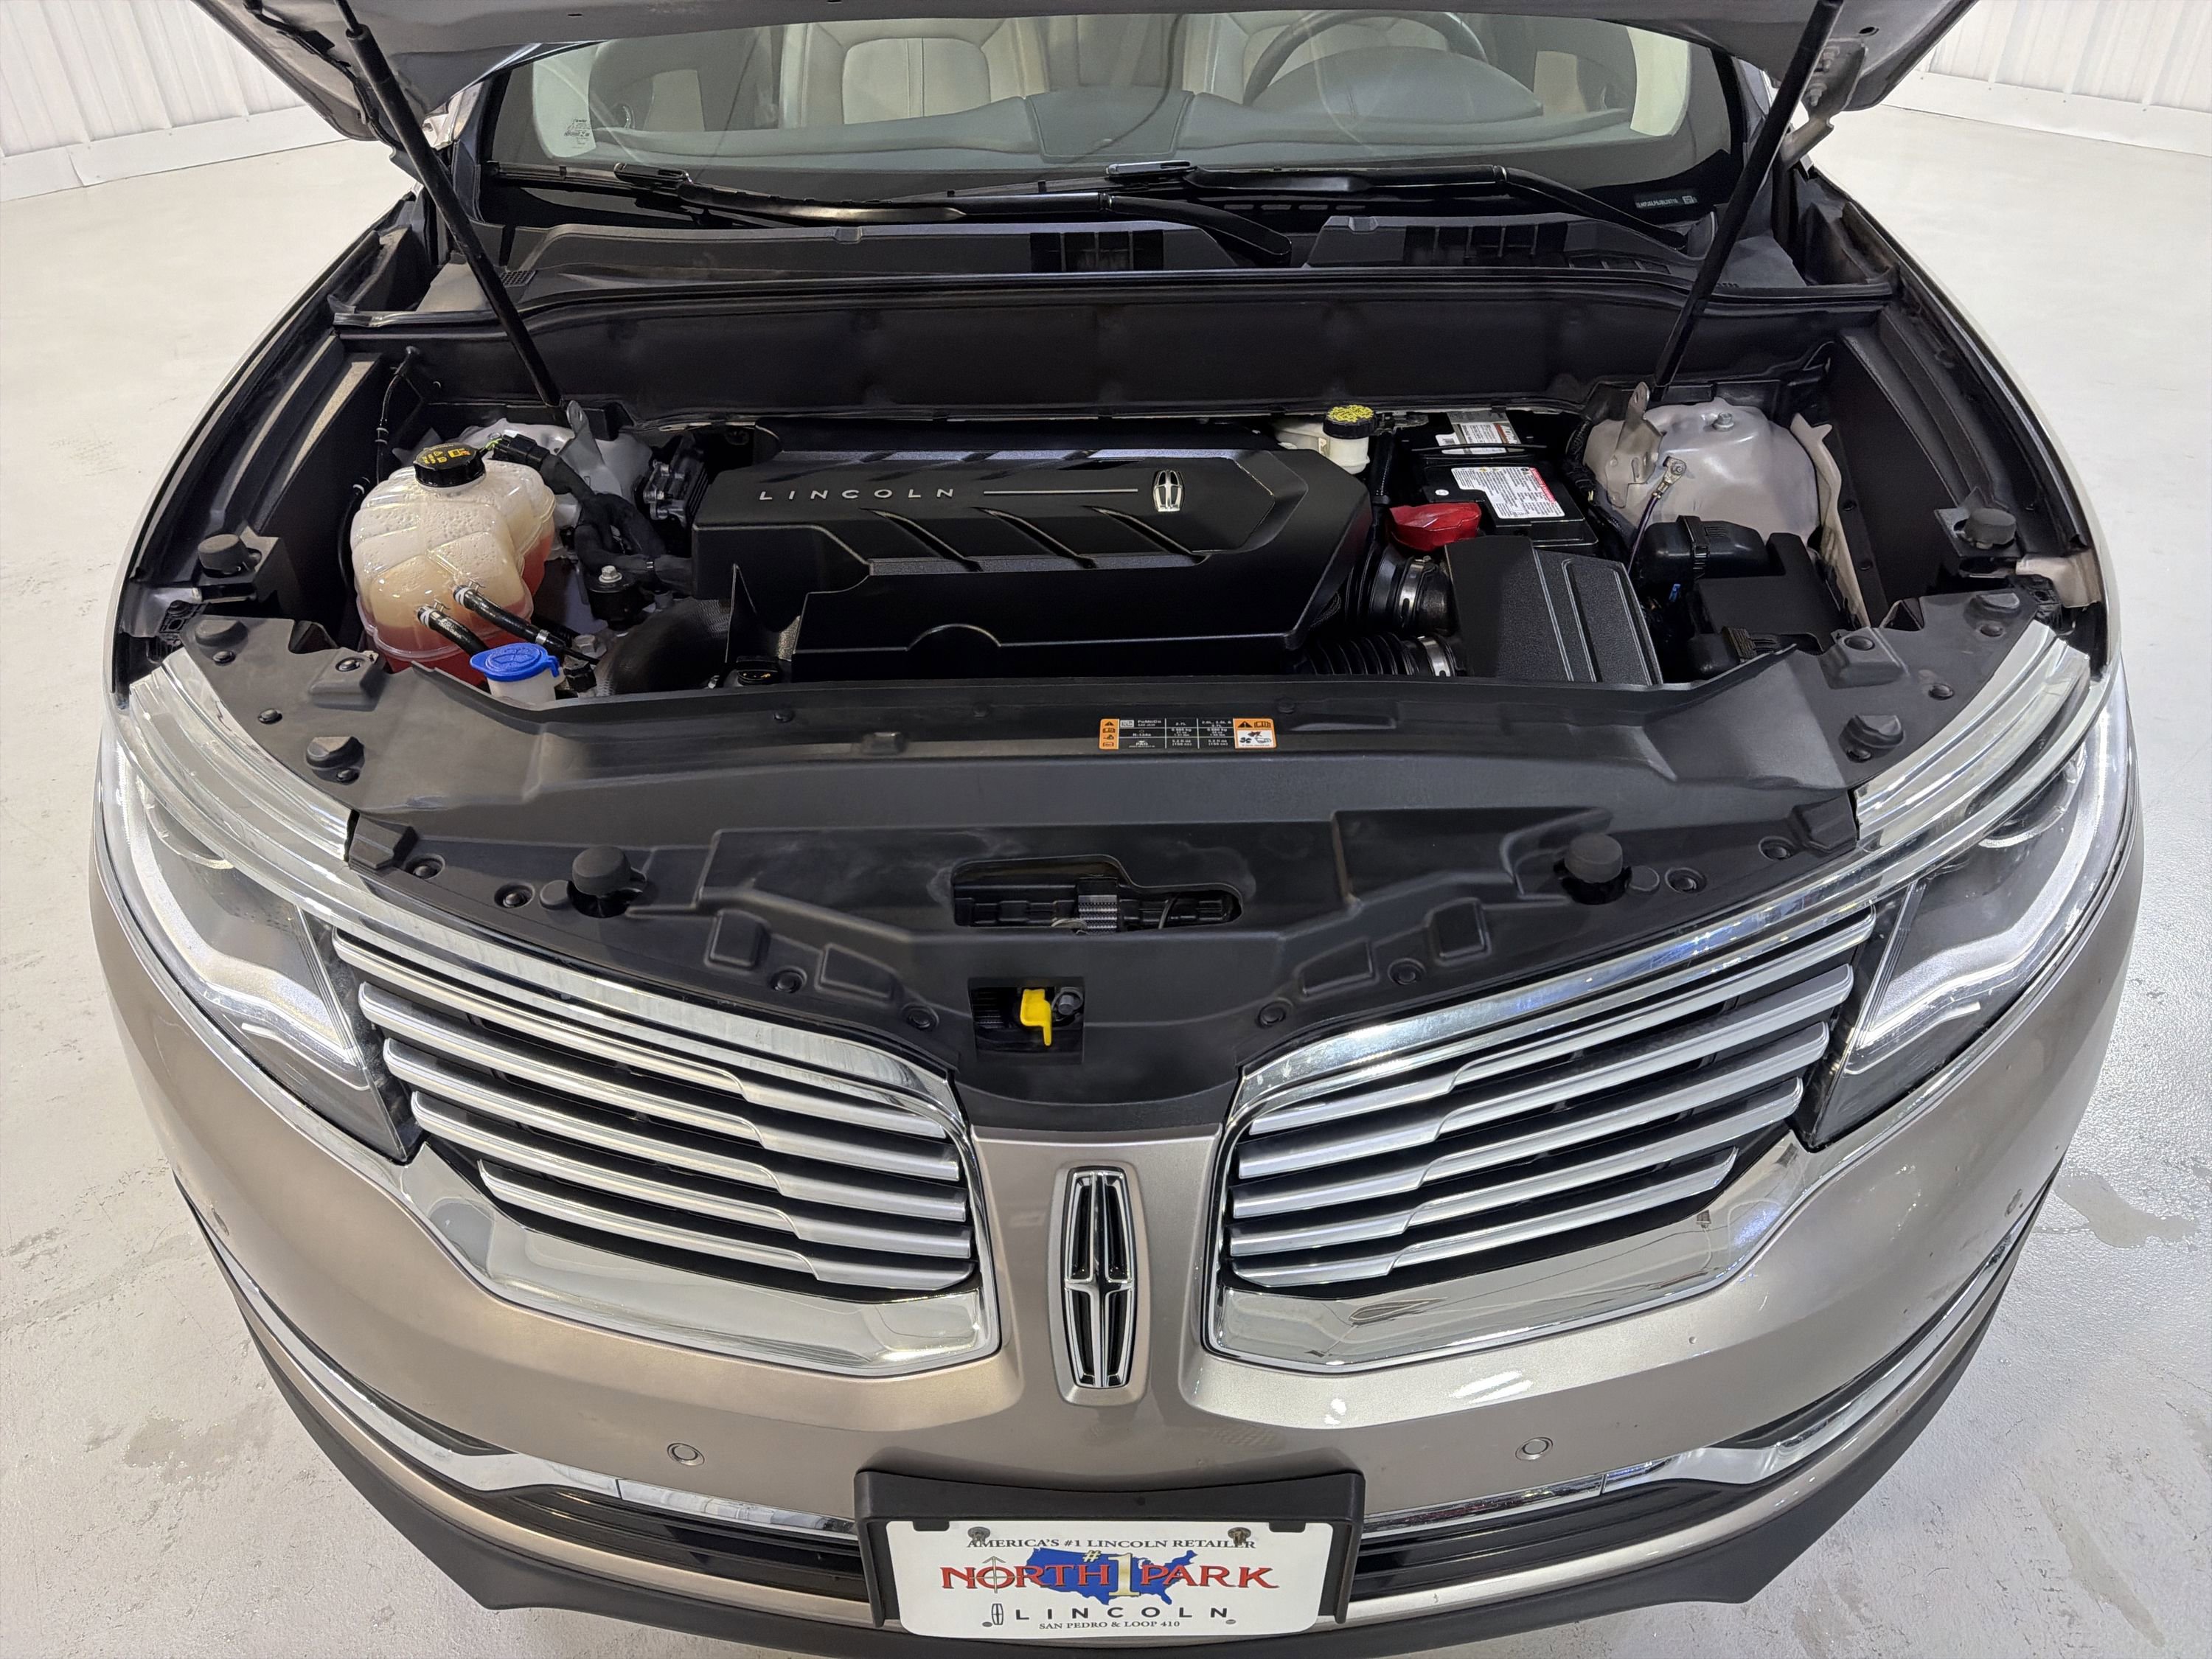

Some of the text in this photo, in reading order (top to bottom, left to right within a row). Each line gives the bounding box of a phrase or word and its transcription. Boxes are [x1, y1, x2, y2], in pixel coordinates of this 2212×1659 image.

[759, 488, 954, 501] LINCOLN
[967, 1539, 1060, 1548] AMERICA'S
[1088, 1540, 1167, 1548] LINCOLN
[940, 1564, 1280, 1589] NORTH PARK
[1015, 1607, 1228, 1620] LINCOLN
